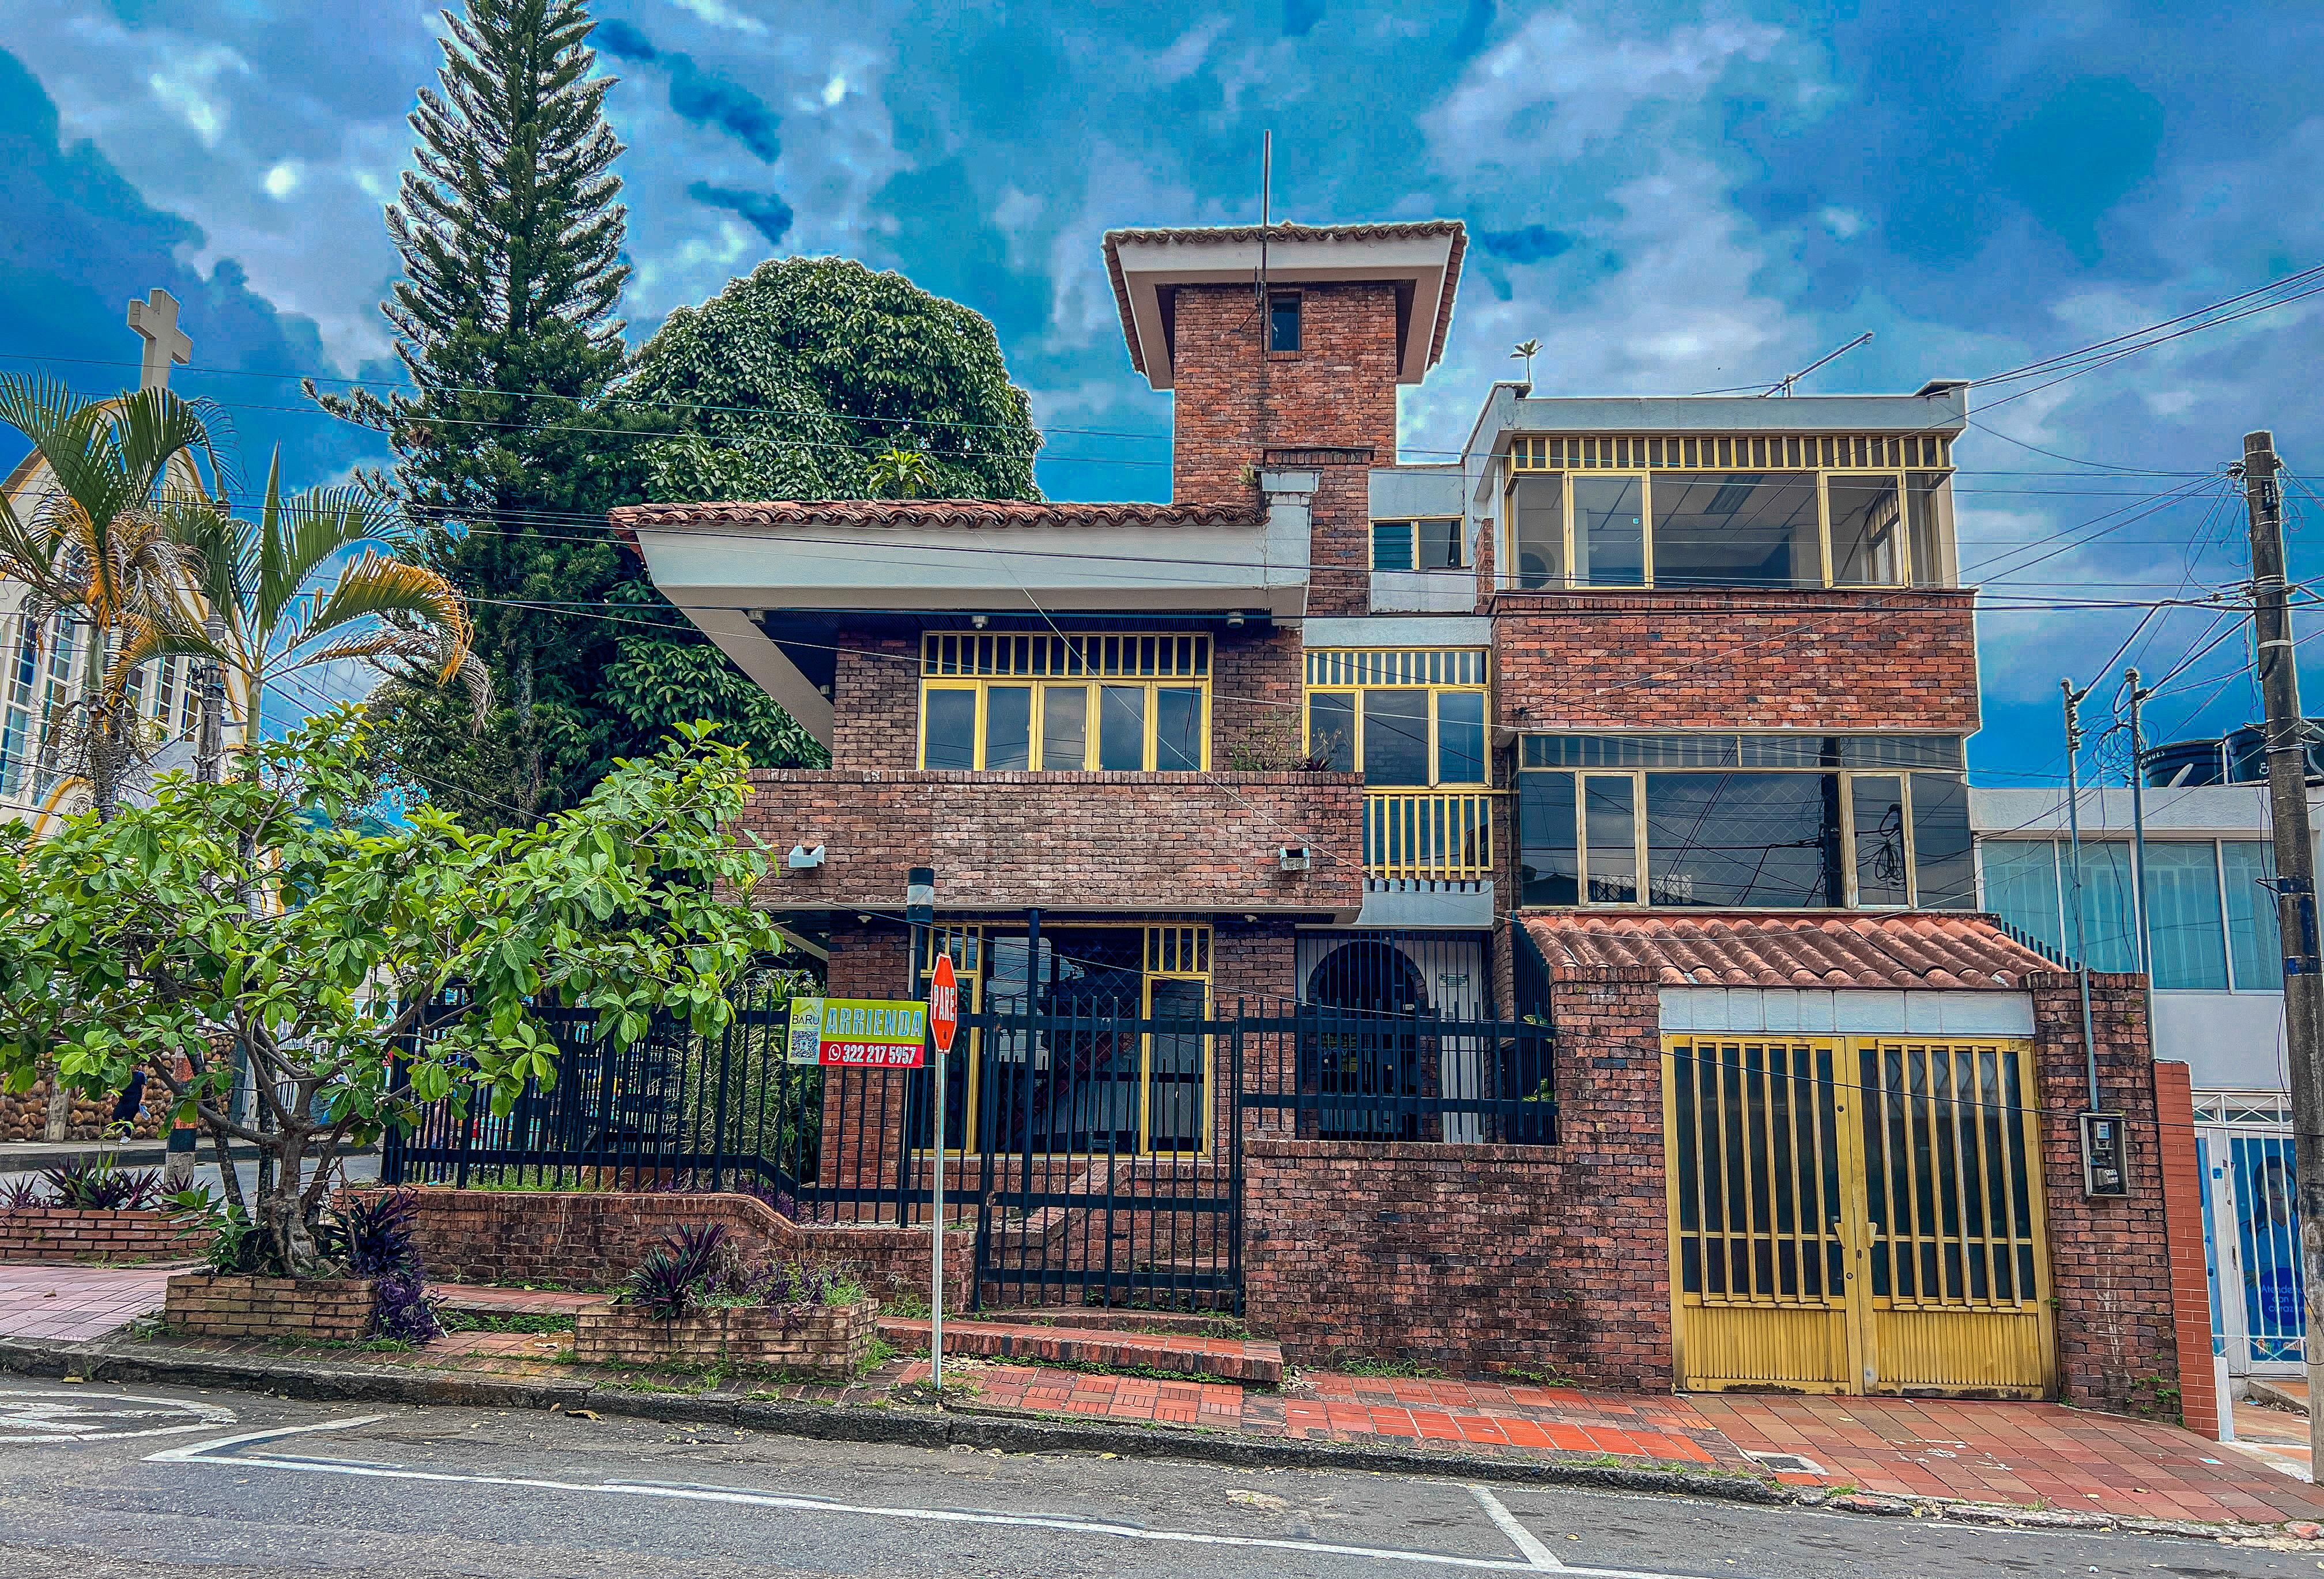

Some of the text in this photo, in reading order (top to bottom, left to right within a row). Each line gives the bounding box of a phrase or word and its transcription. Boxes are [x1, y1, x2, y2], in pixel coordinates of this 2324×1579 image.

[933, 984, 954, 1022] PARE
[825, 1007, 923, 1037] ARRIENDA
[842, 1044, 916, 1064] 322 217 5957
